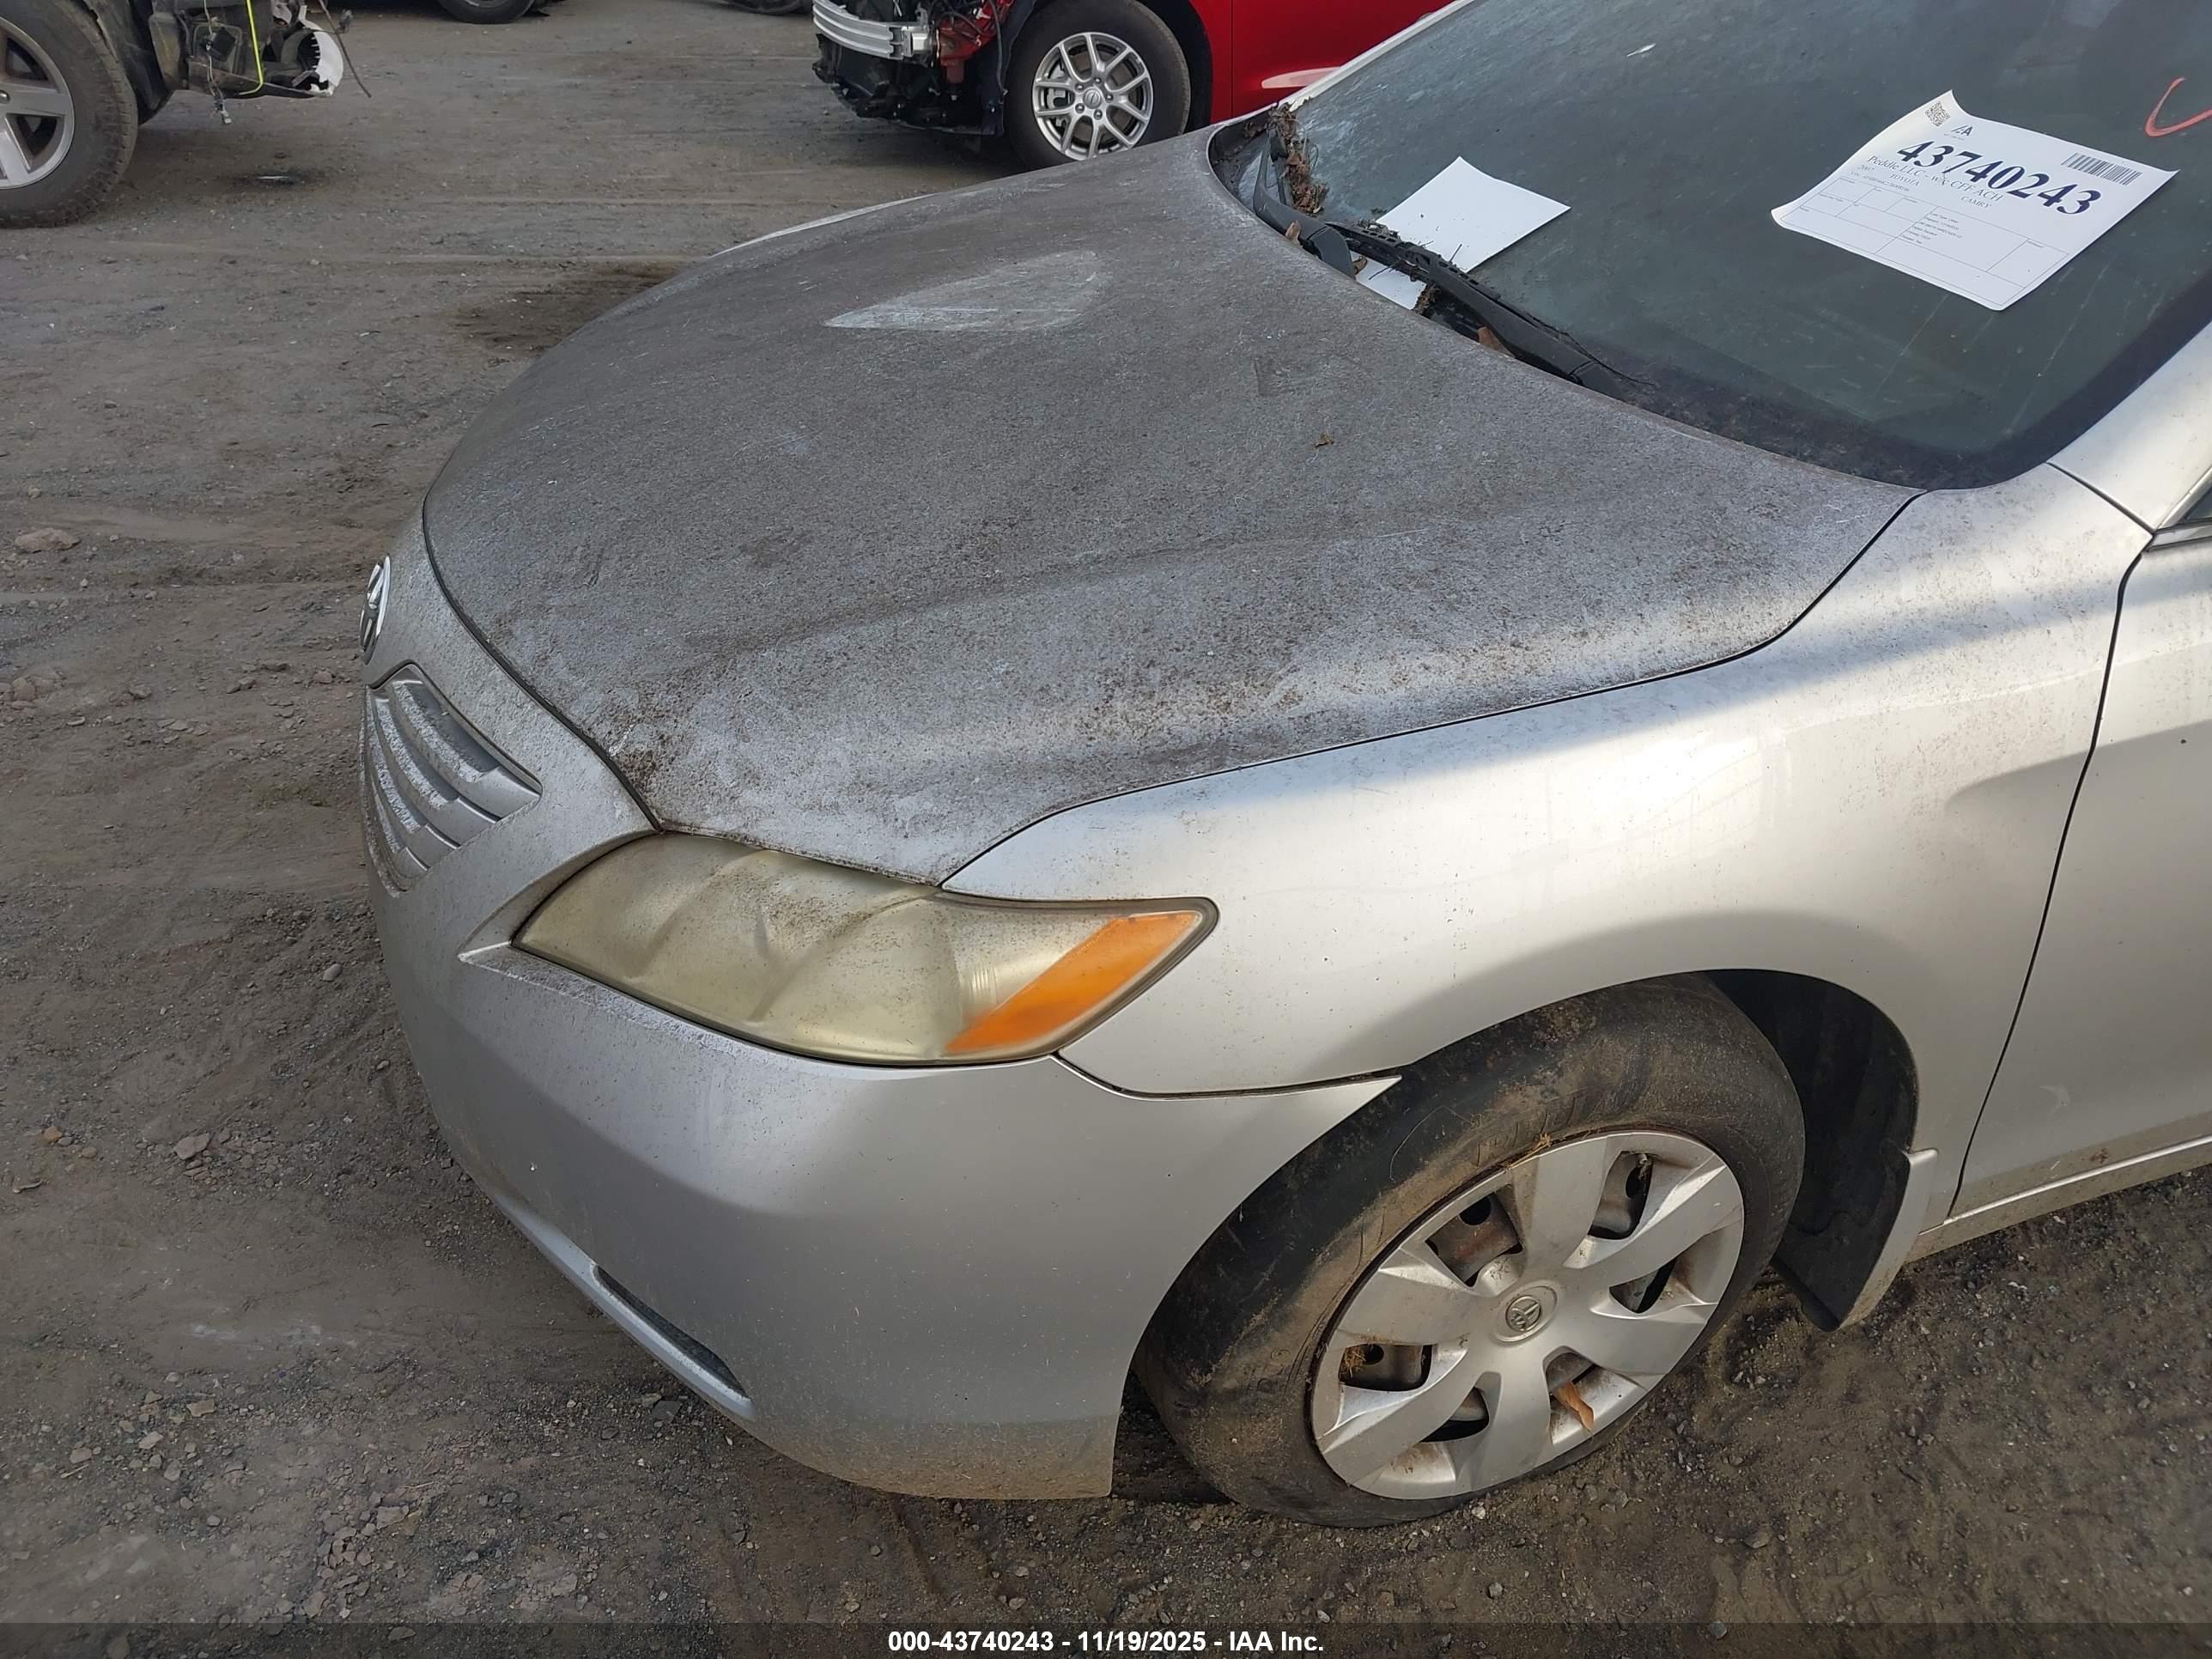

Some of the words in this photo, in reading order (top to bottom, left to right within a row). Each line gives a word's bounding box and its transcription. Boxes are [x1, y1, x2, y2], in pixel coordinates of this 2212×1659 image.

[1867, 155, 1899, 171] Peddle
[1899, 165, 1926, 177] LLC
[1973, 189, 2004, 202] ACH
[1890, 173, 1920, 186] TOYOTA
[1960, 196, 1992, 208] CAMRY
[1896, 141, 2101, 215] 43740243
